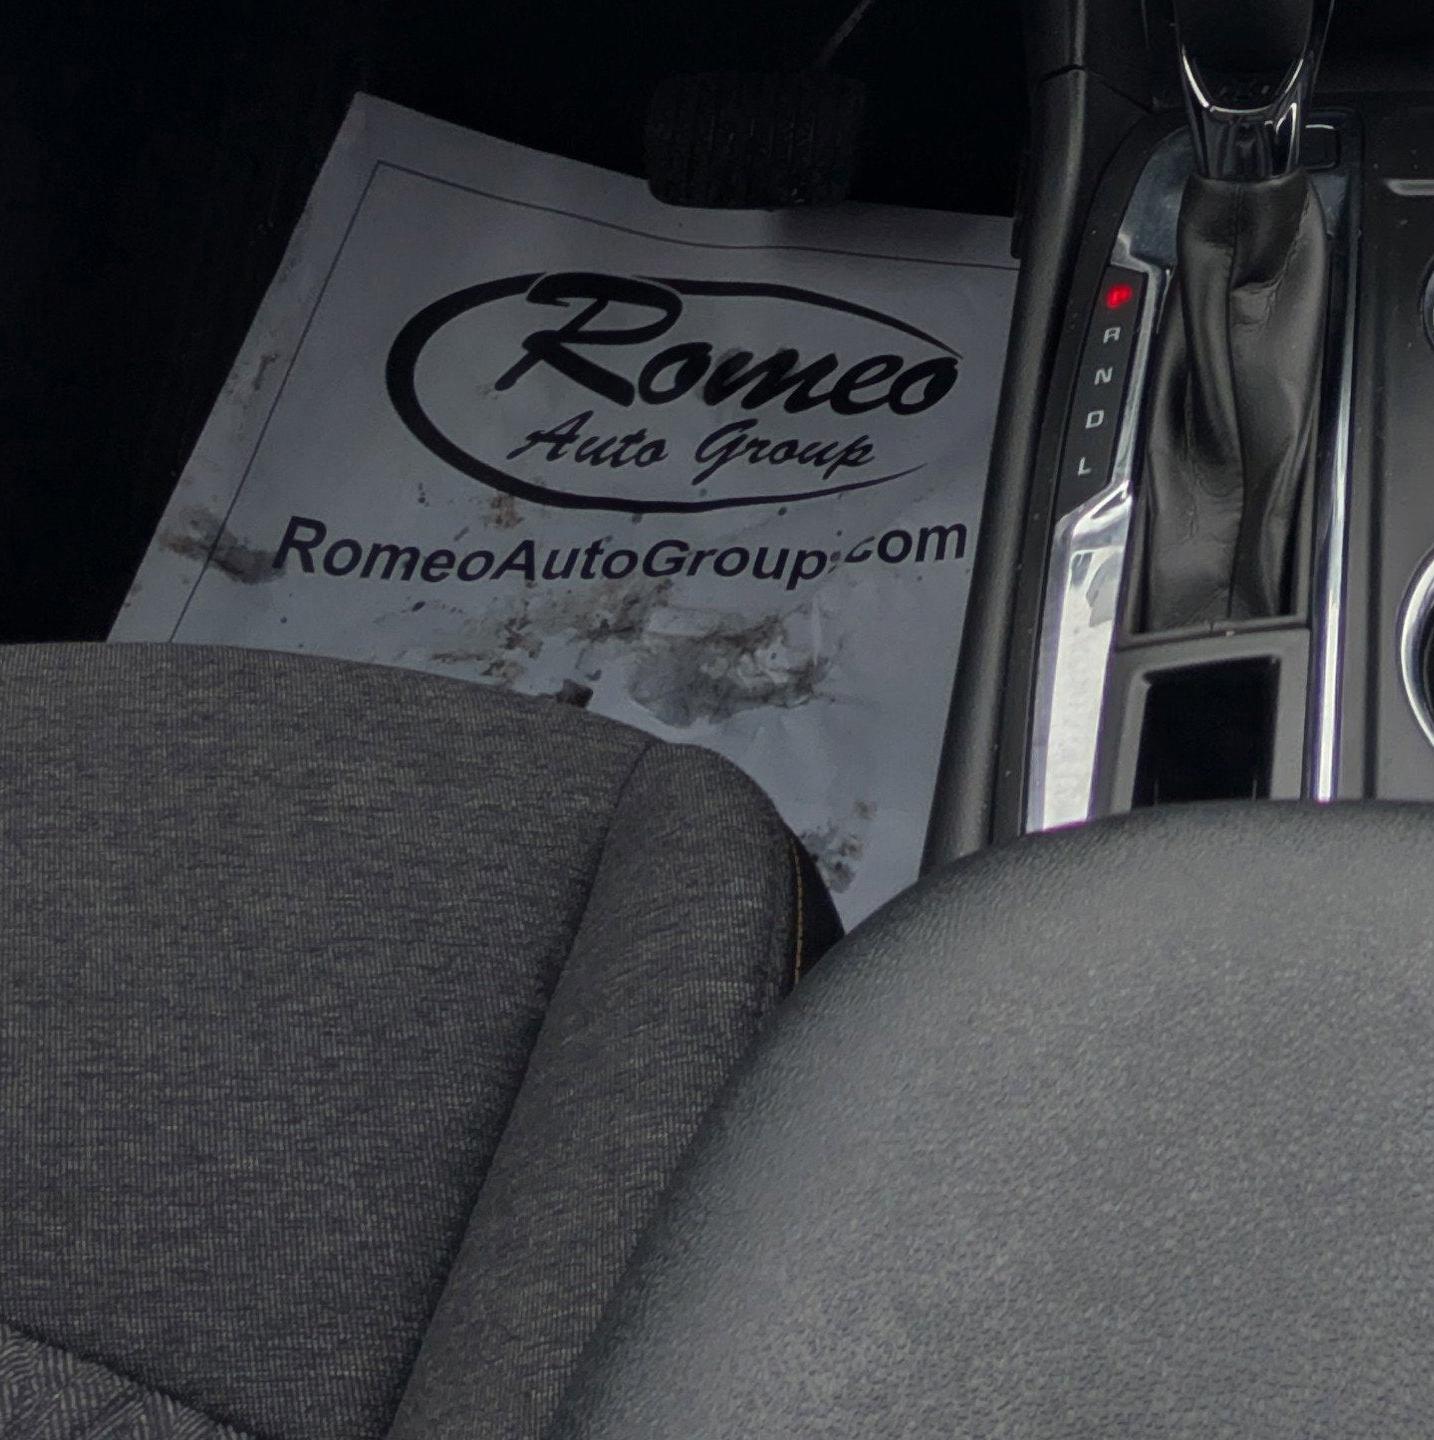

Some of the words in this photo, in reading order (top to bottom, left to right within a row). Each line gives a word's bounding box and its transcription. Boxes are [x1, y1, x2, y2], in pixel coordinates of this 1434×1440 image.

[495, 272, 961, 416] Romeo
[1094, 367, 1113, 386] N
[1085, 411, 1104, 430] D
[507, 410, 669, 465] Auto
[693, 419, 877, 484] Group
[1077, 457, 1092, 476] L
[272, 515, 968, 591] RomeoAutoGroup.com
